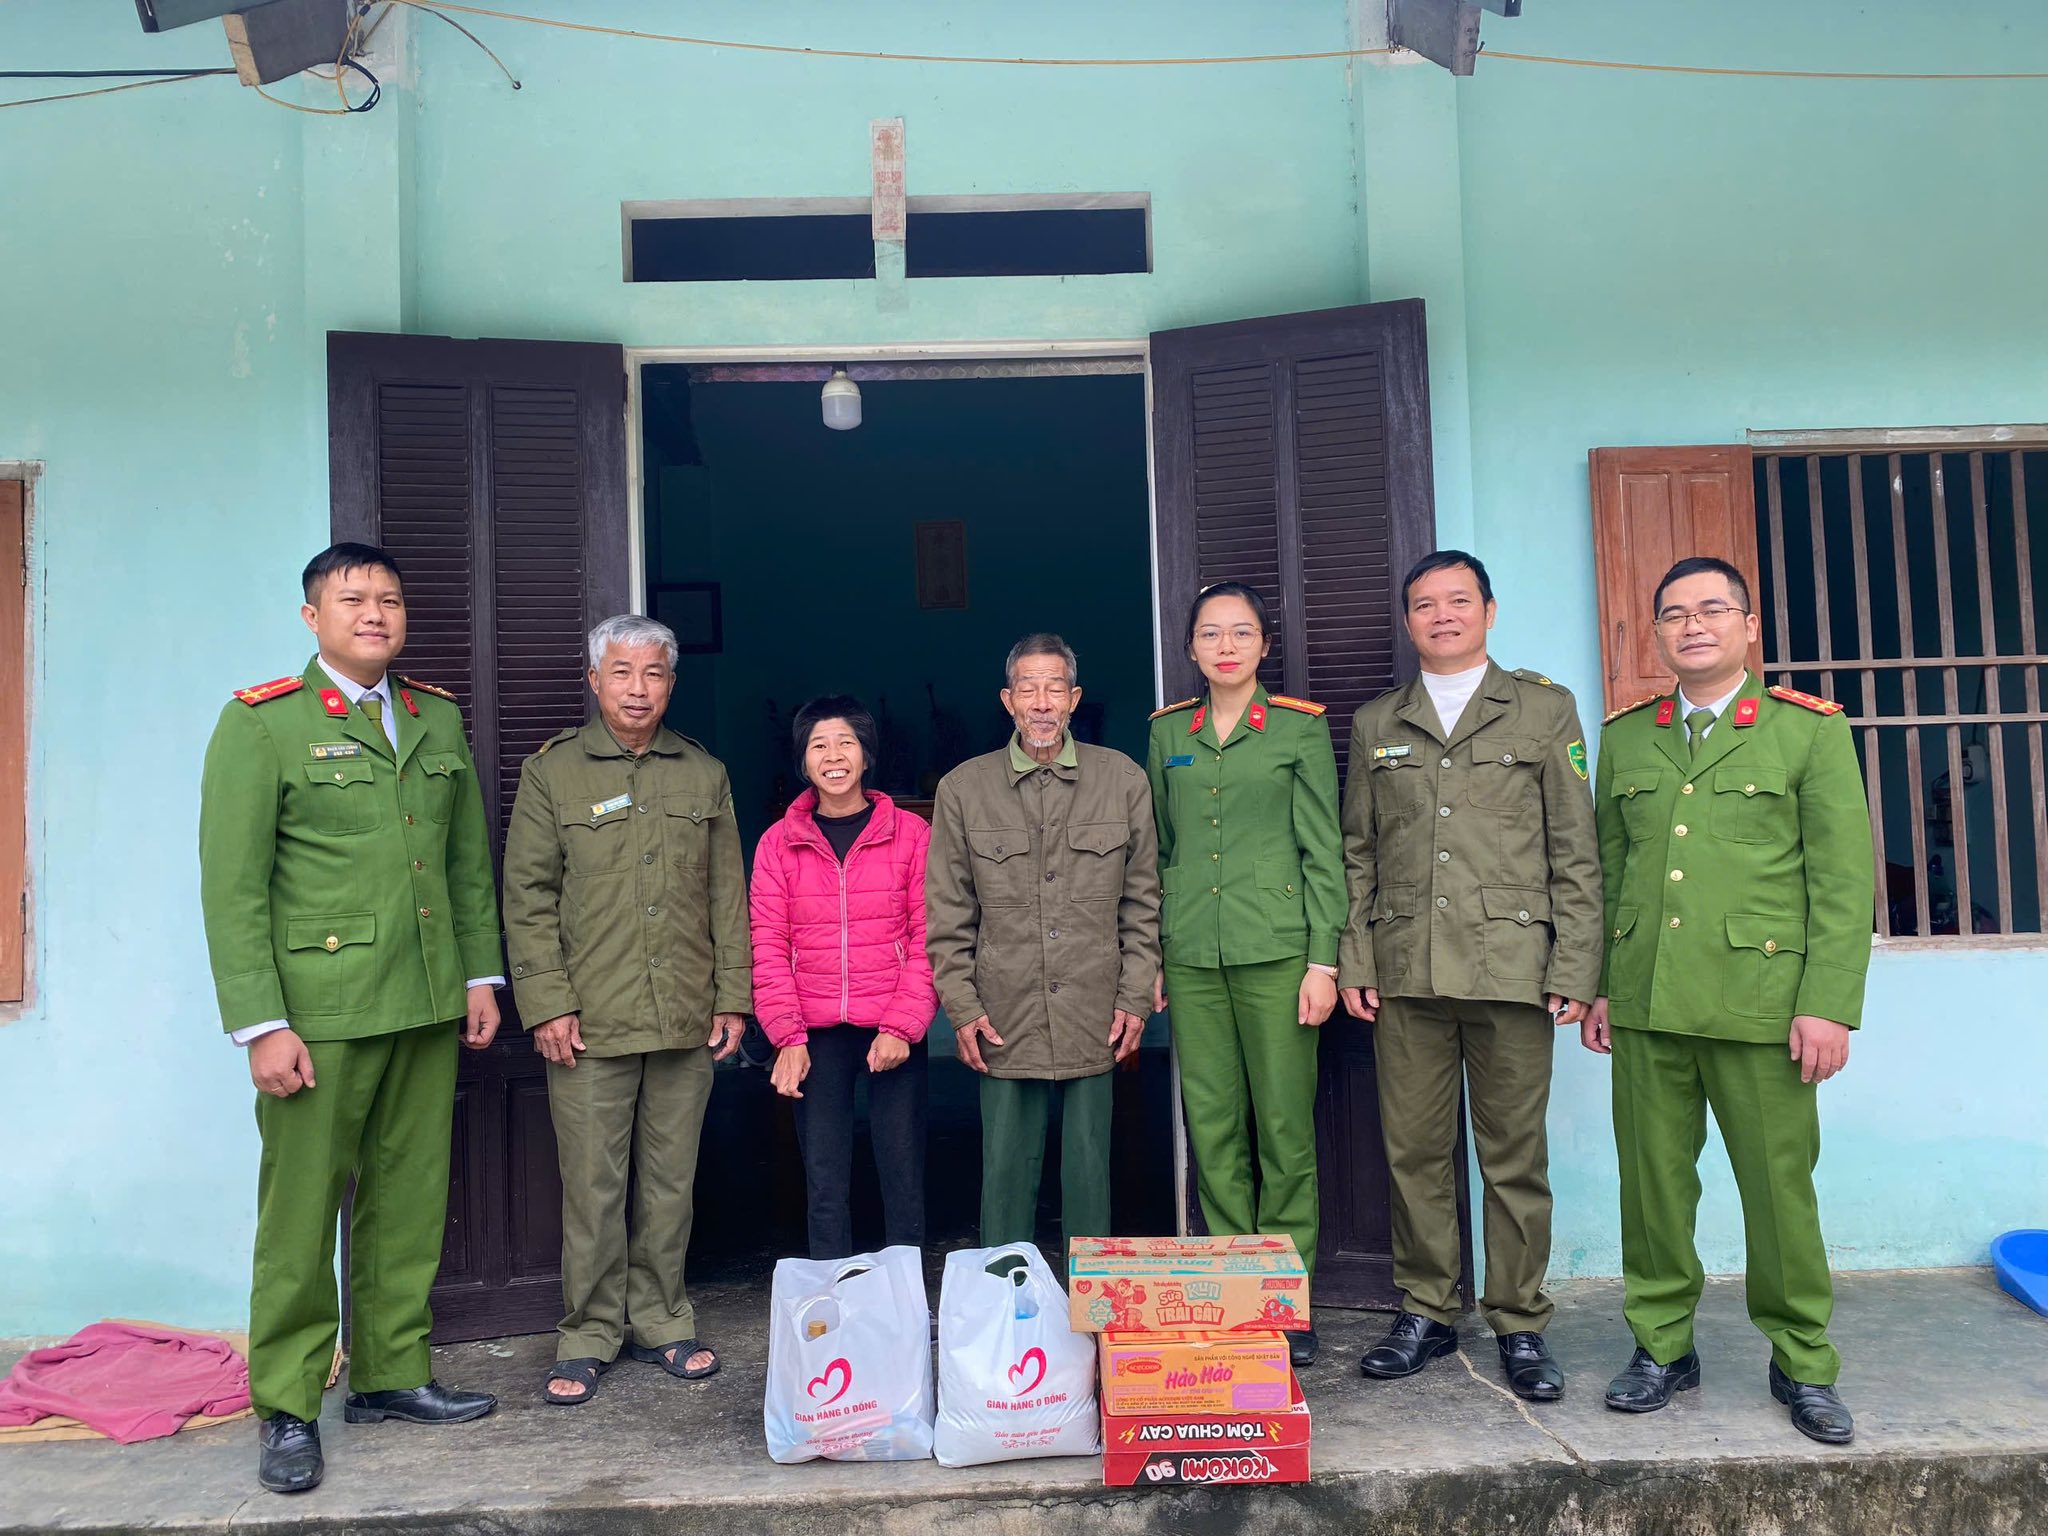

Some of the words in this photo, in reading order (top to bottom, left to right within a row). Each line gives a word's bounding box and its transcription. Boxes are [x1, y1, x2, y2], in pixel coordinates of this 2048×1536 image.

[1156, 1302, 1192, 1326] TRÁI
[1192, 1302, 1225, 1326] CÂY
[1165, 1367, 1198, 1389] Hảo
[1200, 1362, 1233, 1384] Hảo
[987, 1399, 1008, 1410] GIAN
[1010, 1399, 1034, 1411] HÀNG
[795, 1412, 815, 1422] GIAN
[817, 1407, 841, 1420] HÀNG
[1140, 1426, 1173, 1440] CAY
[1176, 1424, 1223, 1438] CHUA
[1227, 1423, 1265, 1440] TÔM
[1145, 1459, 1176, 1481] 90
[1181, 1456, 1270, 1481] KOKOMI
